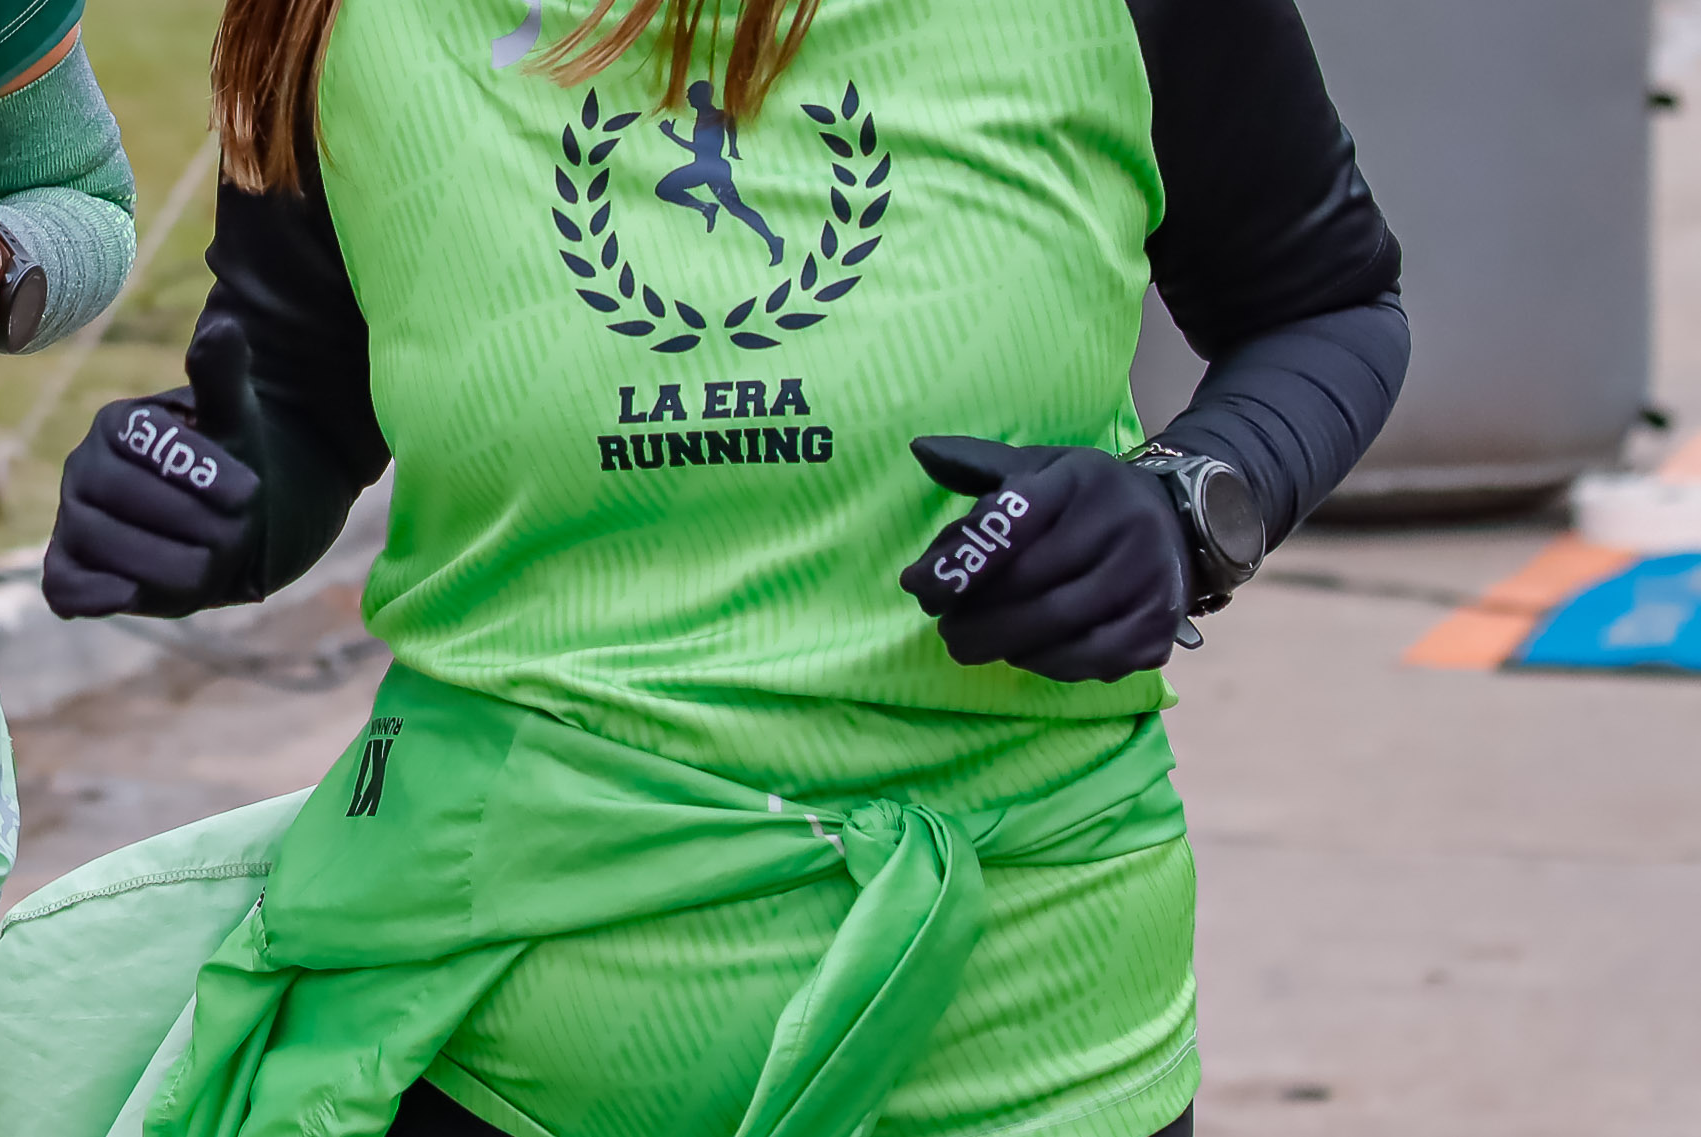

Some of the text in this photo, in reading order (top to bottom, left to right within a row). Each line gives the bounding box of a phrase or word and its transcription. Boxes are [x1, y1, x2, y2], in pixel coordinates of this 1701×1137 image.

[618, 378, 811, 424] LA ERA
[118, 408, 218, 488] Salpa
[597, 425, 833, 472] RUNNING
[934, 490, 1030, 594] Salpa
